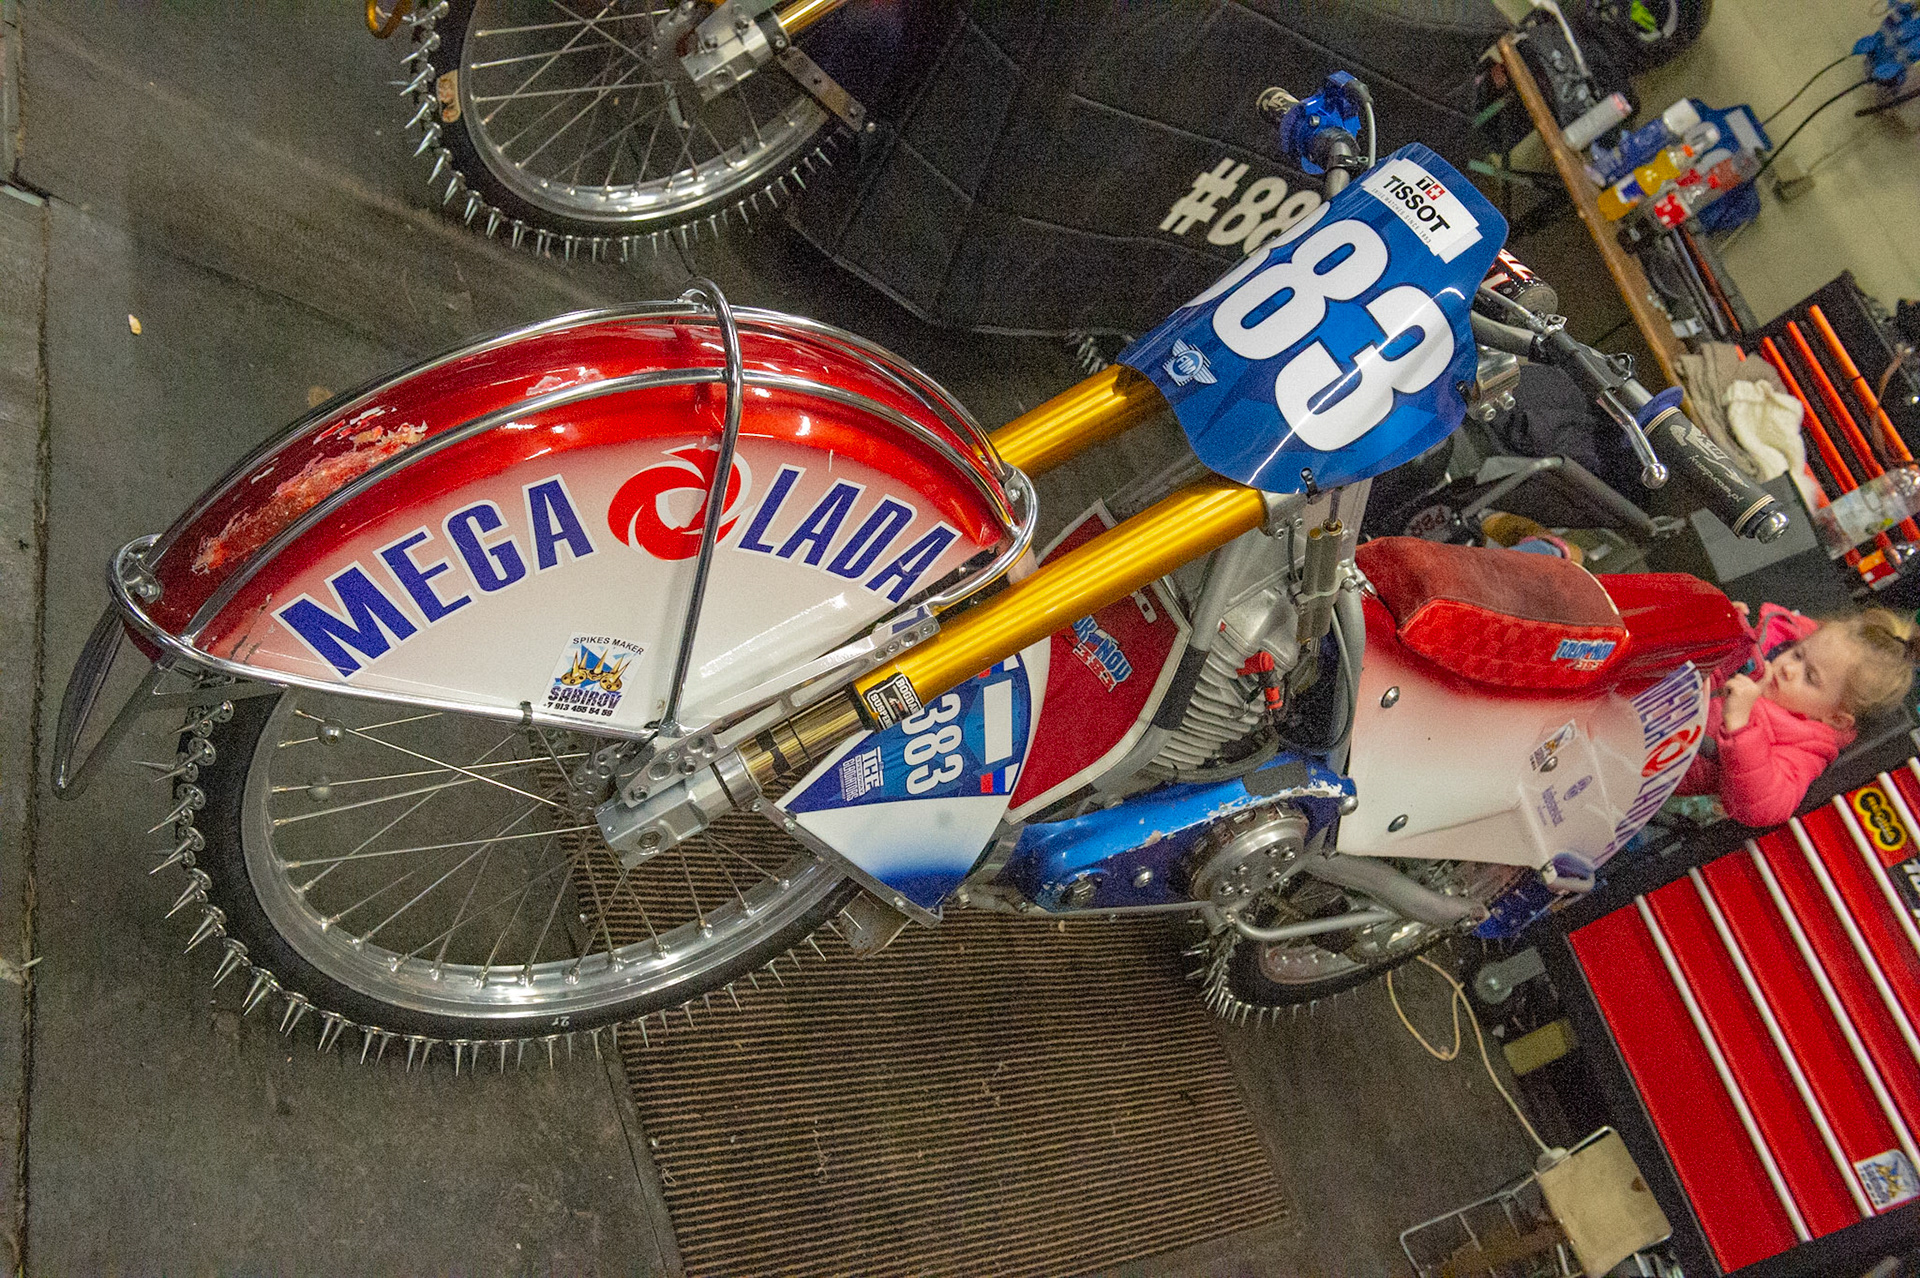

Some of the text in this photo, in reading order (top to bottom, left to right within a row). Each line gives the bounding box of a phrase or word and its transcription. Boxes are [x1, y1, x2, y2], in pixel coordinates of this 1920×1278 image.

[1383, 175, 1451, 232] TISSOT
[1404, 214, 1419, 230] SINCE
[1180, 202, 1455, 452] 83
[1176, 355, 1197, 375] FIM
[274, 466, 960, 680] MEGA LADA
[572, 636, 645, 655] SPIKES MAKER
[548, 686, 622, 709] SABIROV
[554, 702, 569, 711] 913
[571, 705, 587, 713] 455
[588, 707, 600, 715] 54
[601, 709, 613, 717] 59
[903, 693, 964, 795] 383
[861, 748, 881, 793] ICE
